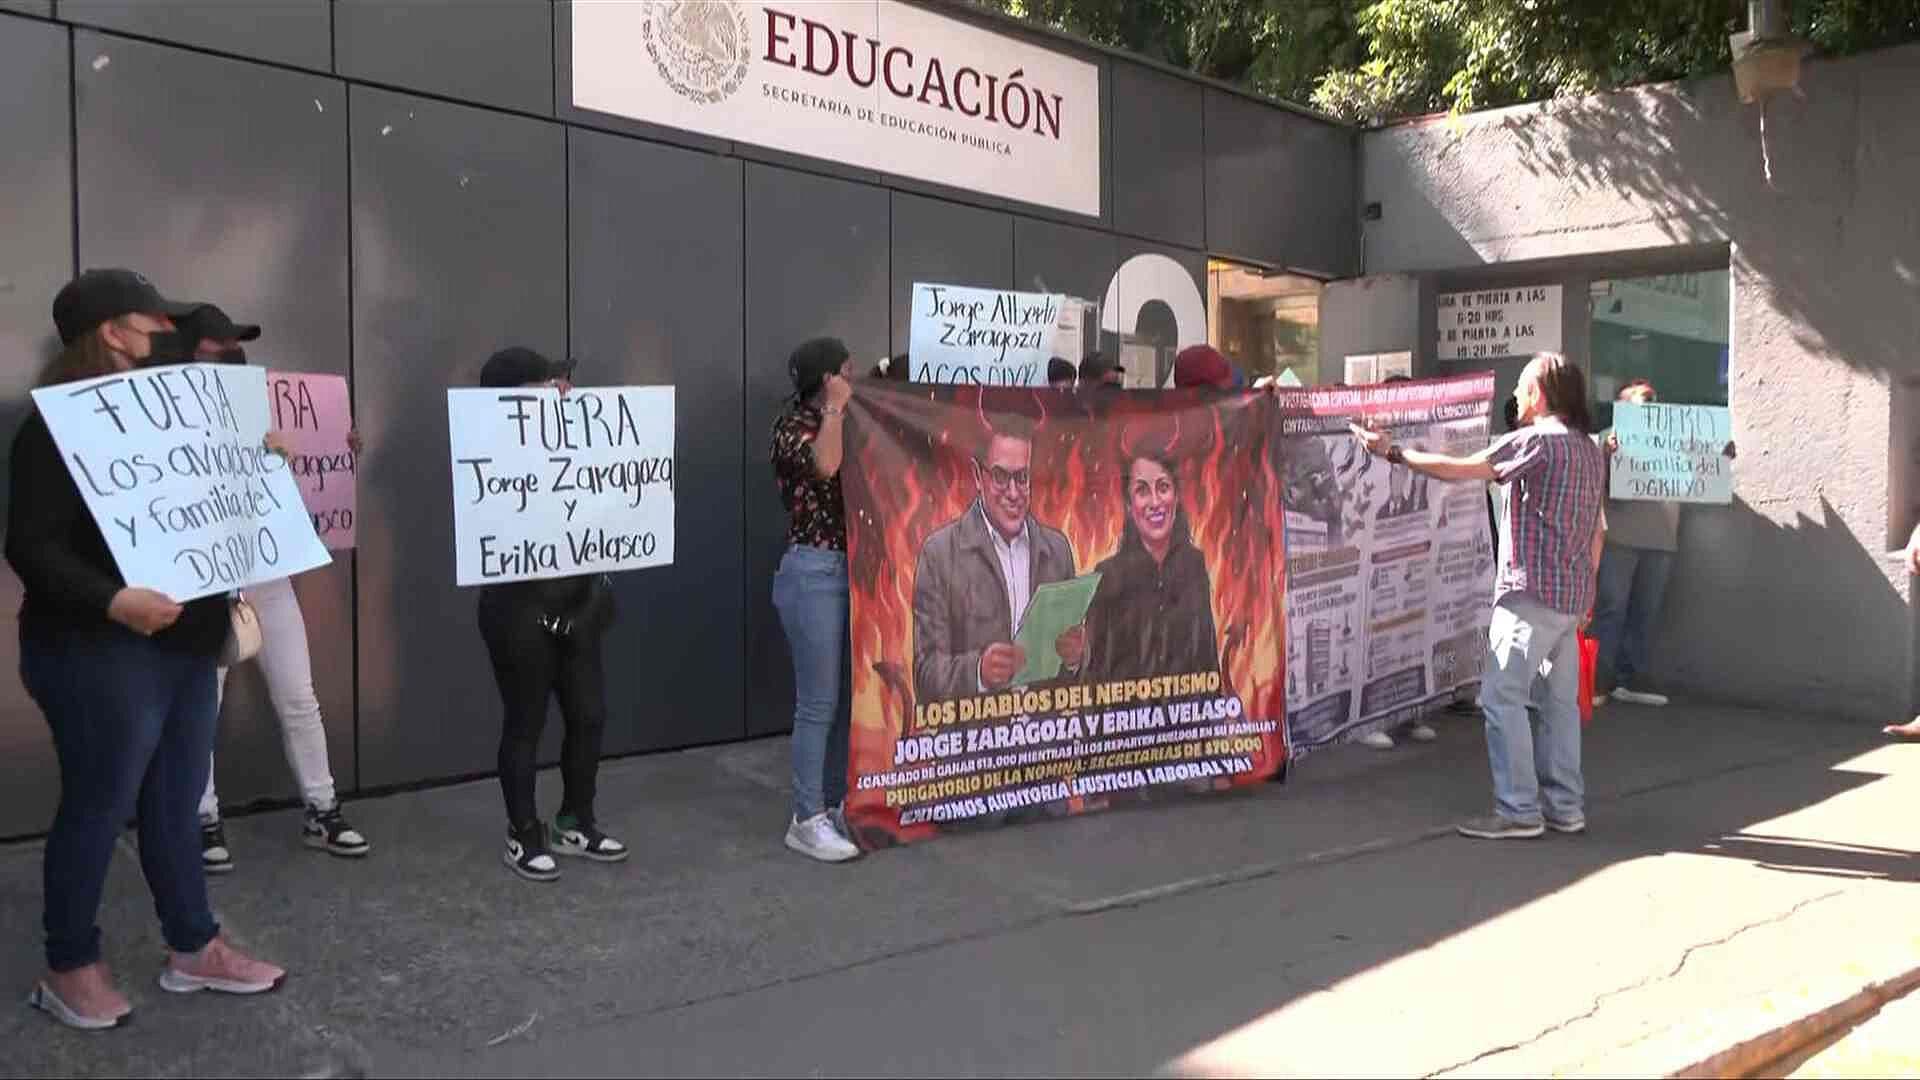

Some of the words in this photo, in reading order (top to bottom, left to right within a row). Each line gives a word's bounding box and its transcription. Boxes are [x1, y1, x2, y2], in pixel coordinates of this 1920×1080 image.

[762, 7, 1064, 140] EDUCACIÓN
[856, 108, 875, 122] DE
[922, 287, 984, 332] Jorge
[1527, 288, 1546, 302] LAS
[940, 323, 1042, 362] Zaragoza
[1515, 324, 1534, 337] LAS
[68, 367, 240, 434] FUERA
[274, 379, 319, 432] RA
[498, 393, 640, 451] FUERA
[457, 458, 538, 512] Jorge
[549, 456, 673, 508] Zaragoza
[566, 528, 656, 565] Velasco
[915, 700, 956, 729] LOS
[959, 688, 1053, 721] DIABLOS
[1054, 685, 1094, 709] DEL
[1095, 671, 1220, 704] NEPOSTISMO
[895, 731, 964, 765] JORGE
[967, 714, 1083, 752] ZARAGOZA
[1086, 715, 1099, 736] Y
[1102, 705, 1166, 735] ERIKA
[1168, 696, 1241, 725] VELASO
[886, 775, 981, 807] PURGATORIO
[983, 773, 1002, 790] DE
[1004, 769, 1023, 785] LA
[1183, 742, 1202, 758] DE
[1147, 758, 1223, 784] LABORAL
